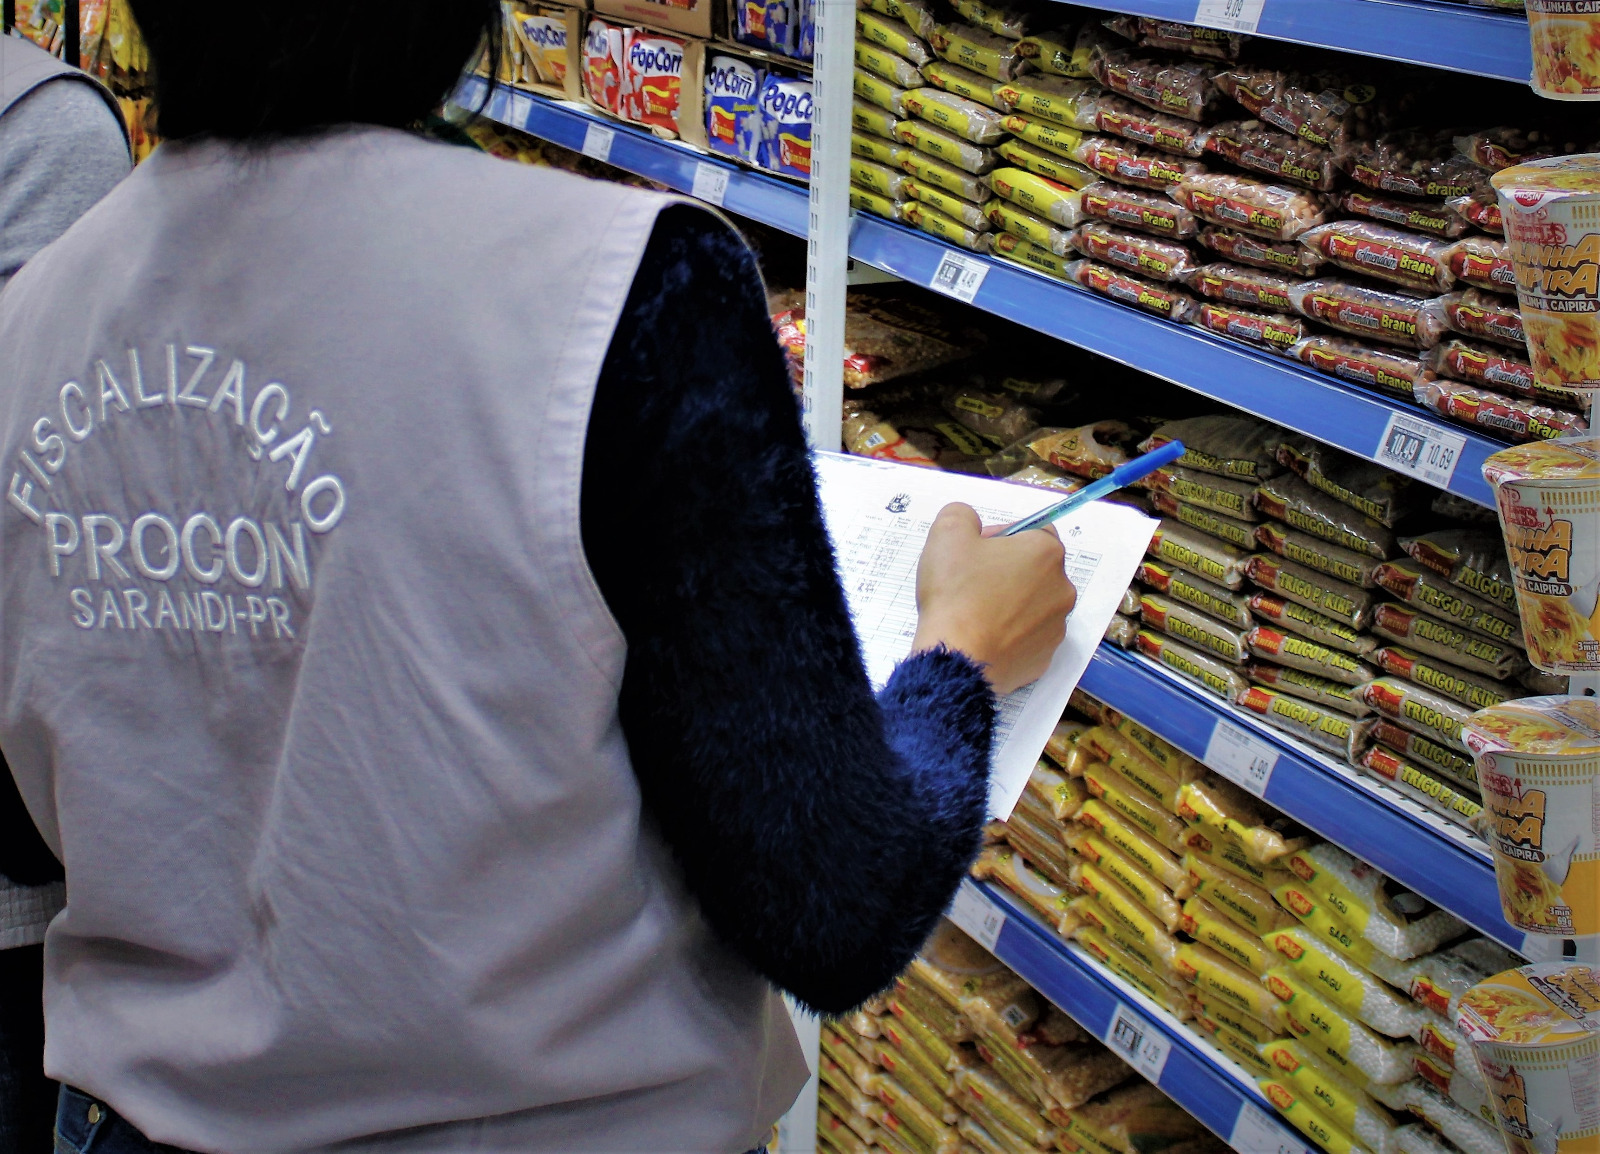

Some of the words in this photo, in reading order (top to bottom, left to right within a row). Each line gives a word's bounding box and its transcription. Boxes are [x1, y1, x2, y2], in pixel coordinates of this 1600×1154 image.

[522, 20, 566, 48] PopCor
[709, 66, 752, 98] opCorn
[764, 84, 813, 120] PopCo
[1033, 95, 1051, 109] TRIGO
[1042, 124, 1058, 137] TRIGO
[1550, 299, 1596, 313] CAIPIRA
[8, 344, 345, 534] FISCALIZAÇÃO
[1528, 418, 1561, 440] Bran
[45, 512, 309, 590] PROCON
[1459, 566, 1500, 598] TRIGO
[1527, 582, 1569, 597] CAIPIRA
[70, 588, 295, 638] SARANDI-PR
[1418, 584, 1461, 616] TRIGO
[1476, 612, 1516, 640] KIBE
[1415, 619, 1452, 645] TRIGO
[1416, 664, 1454, 692] TRIGO
[1273, 698, 1309, 722] TRIGO
[1405, 700, 1443, 731] TRIGO
[1413, 735, 1450, 768] TRIGO
[1402, 765, 1441, 799] TRIGO
[1453, 795, 1483, 818] KIB
[1328, 893, 1347, 914] SAGU
[1328, 926, 1352, 948] SAGU
[1318, 970, 1341, 992] SAGU
[1313, 1085, 1335, 1108] SAGU
[1308, 1120, 1331, 1143] SAGU
